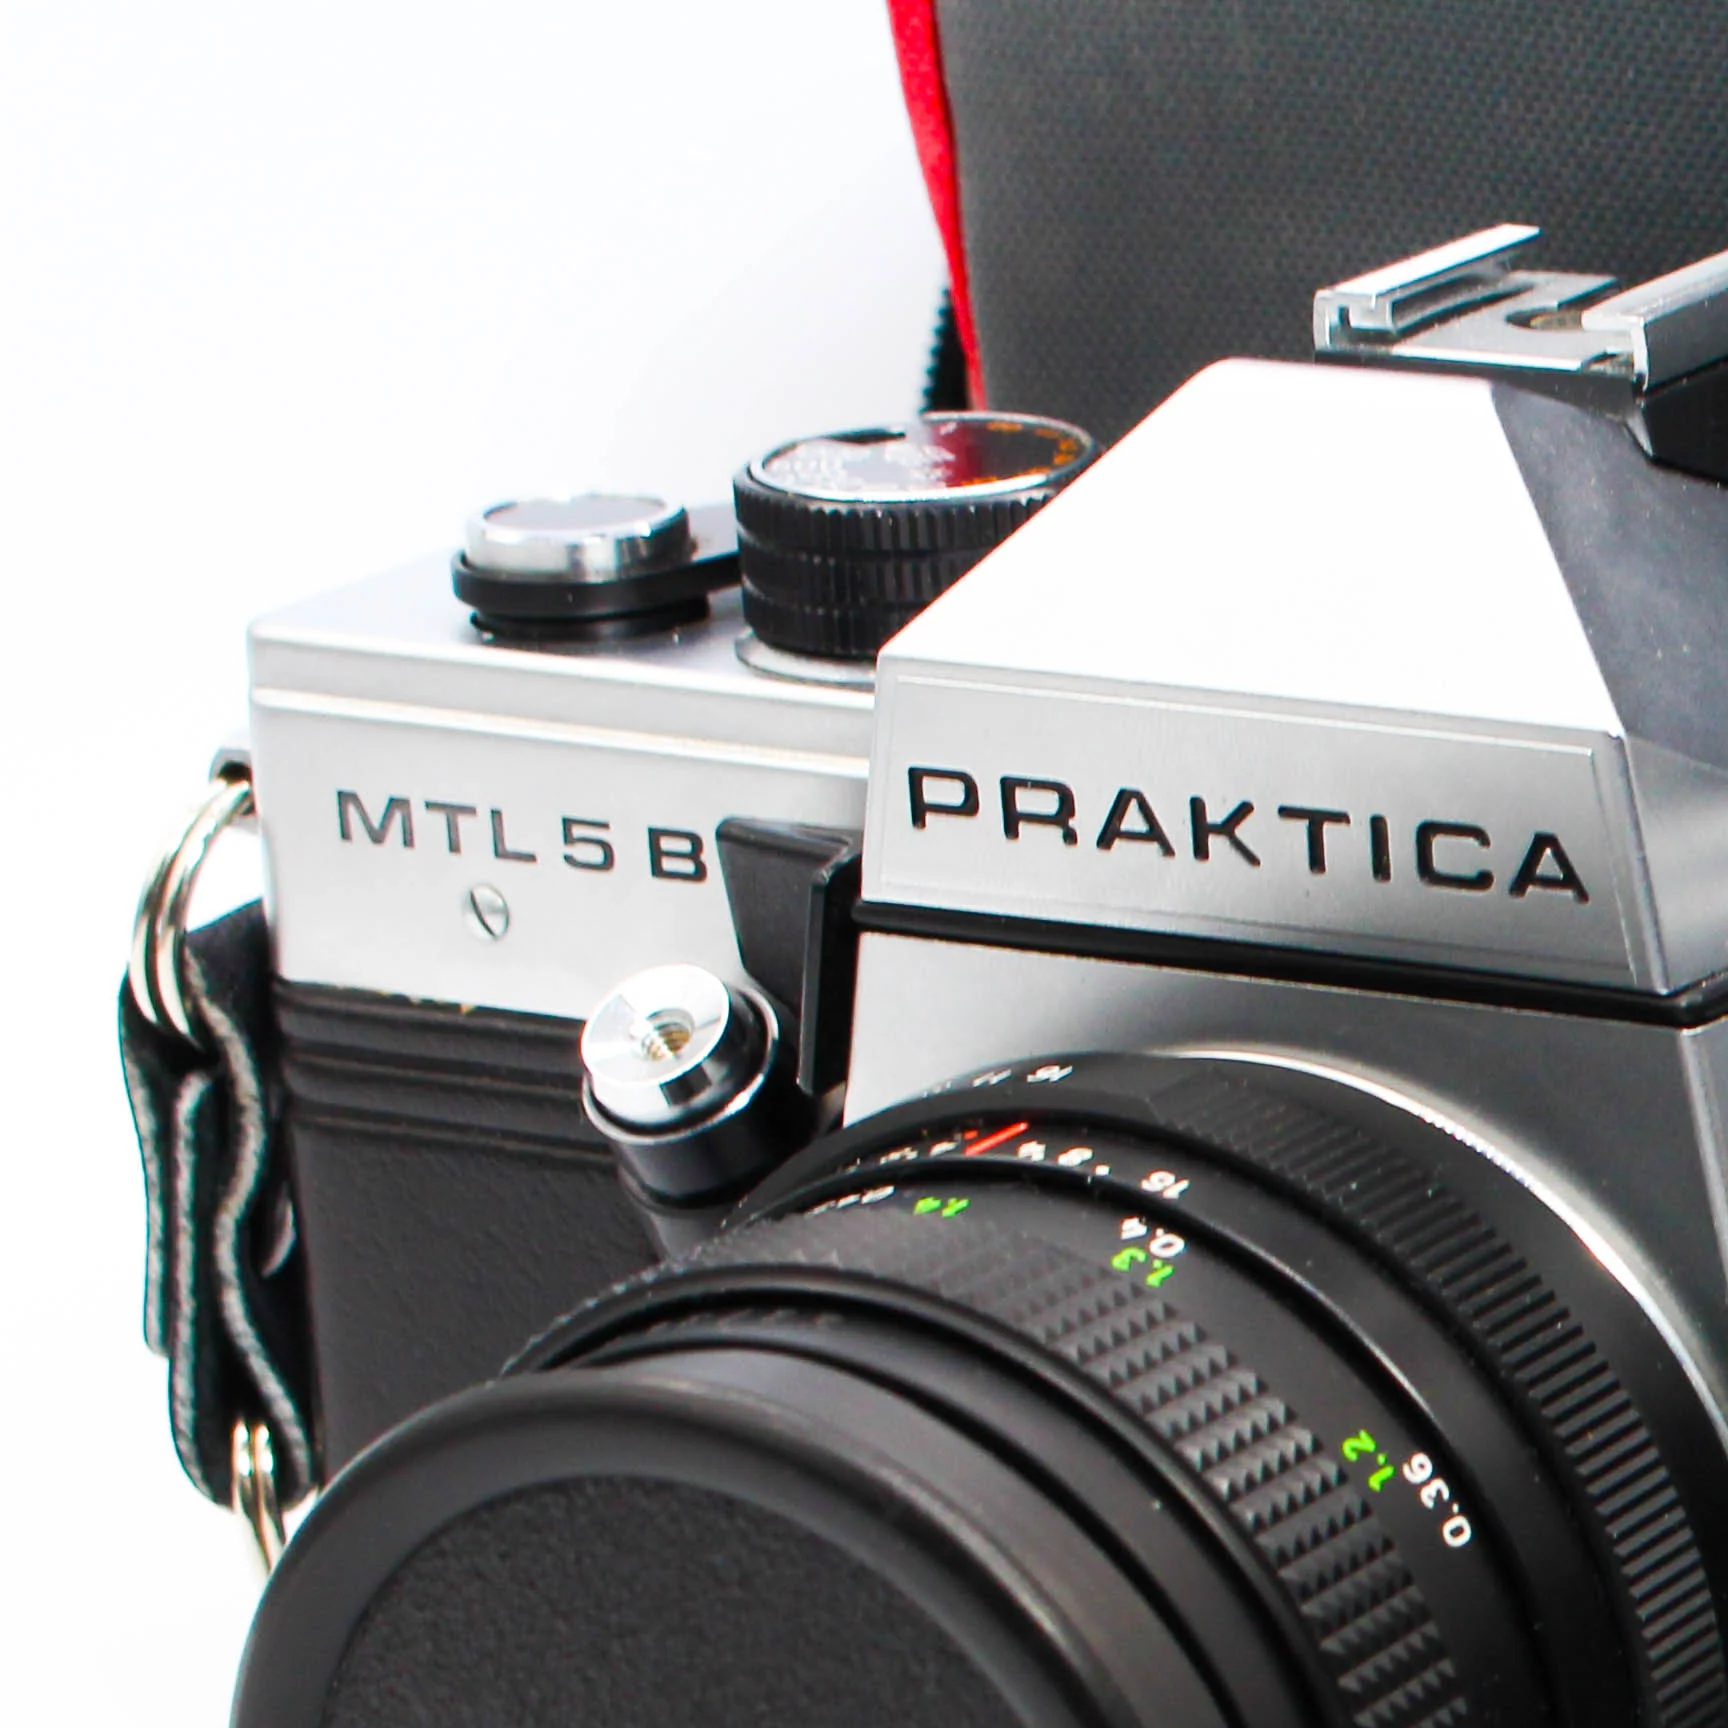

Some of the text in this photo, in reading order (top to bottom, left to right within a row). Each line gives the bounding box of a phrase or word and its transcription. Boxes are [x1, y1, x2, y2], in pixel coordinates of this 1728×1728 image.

[646, 826, 709, 883] B
[906, 766, 1591, 906] PRAKTICA
[1341, 1429, 1397, 1493] 1.2
[1401, 1451, 1473, 1549] 0.36
